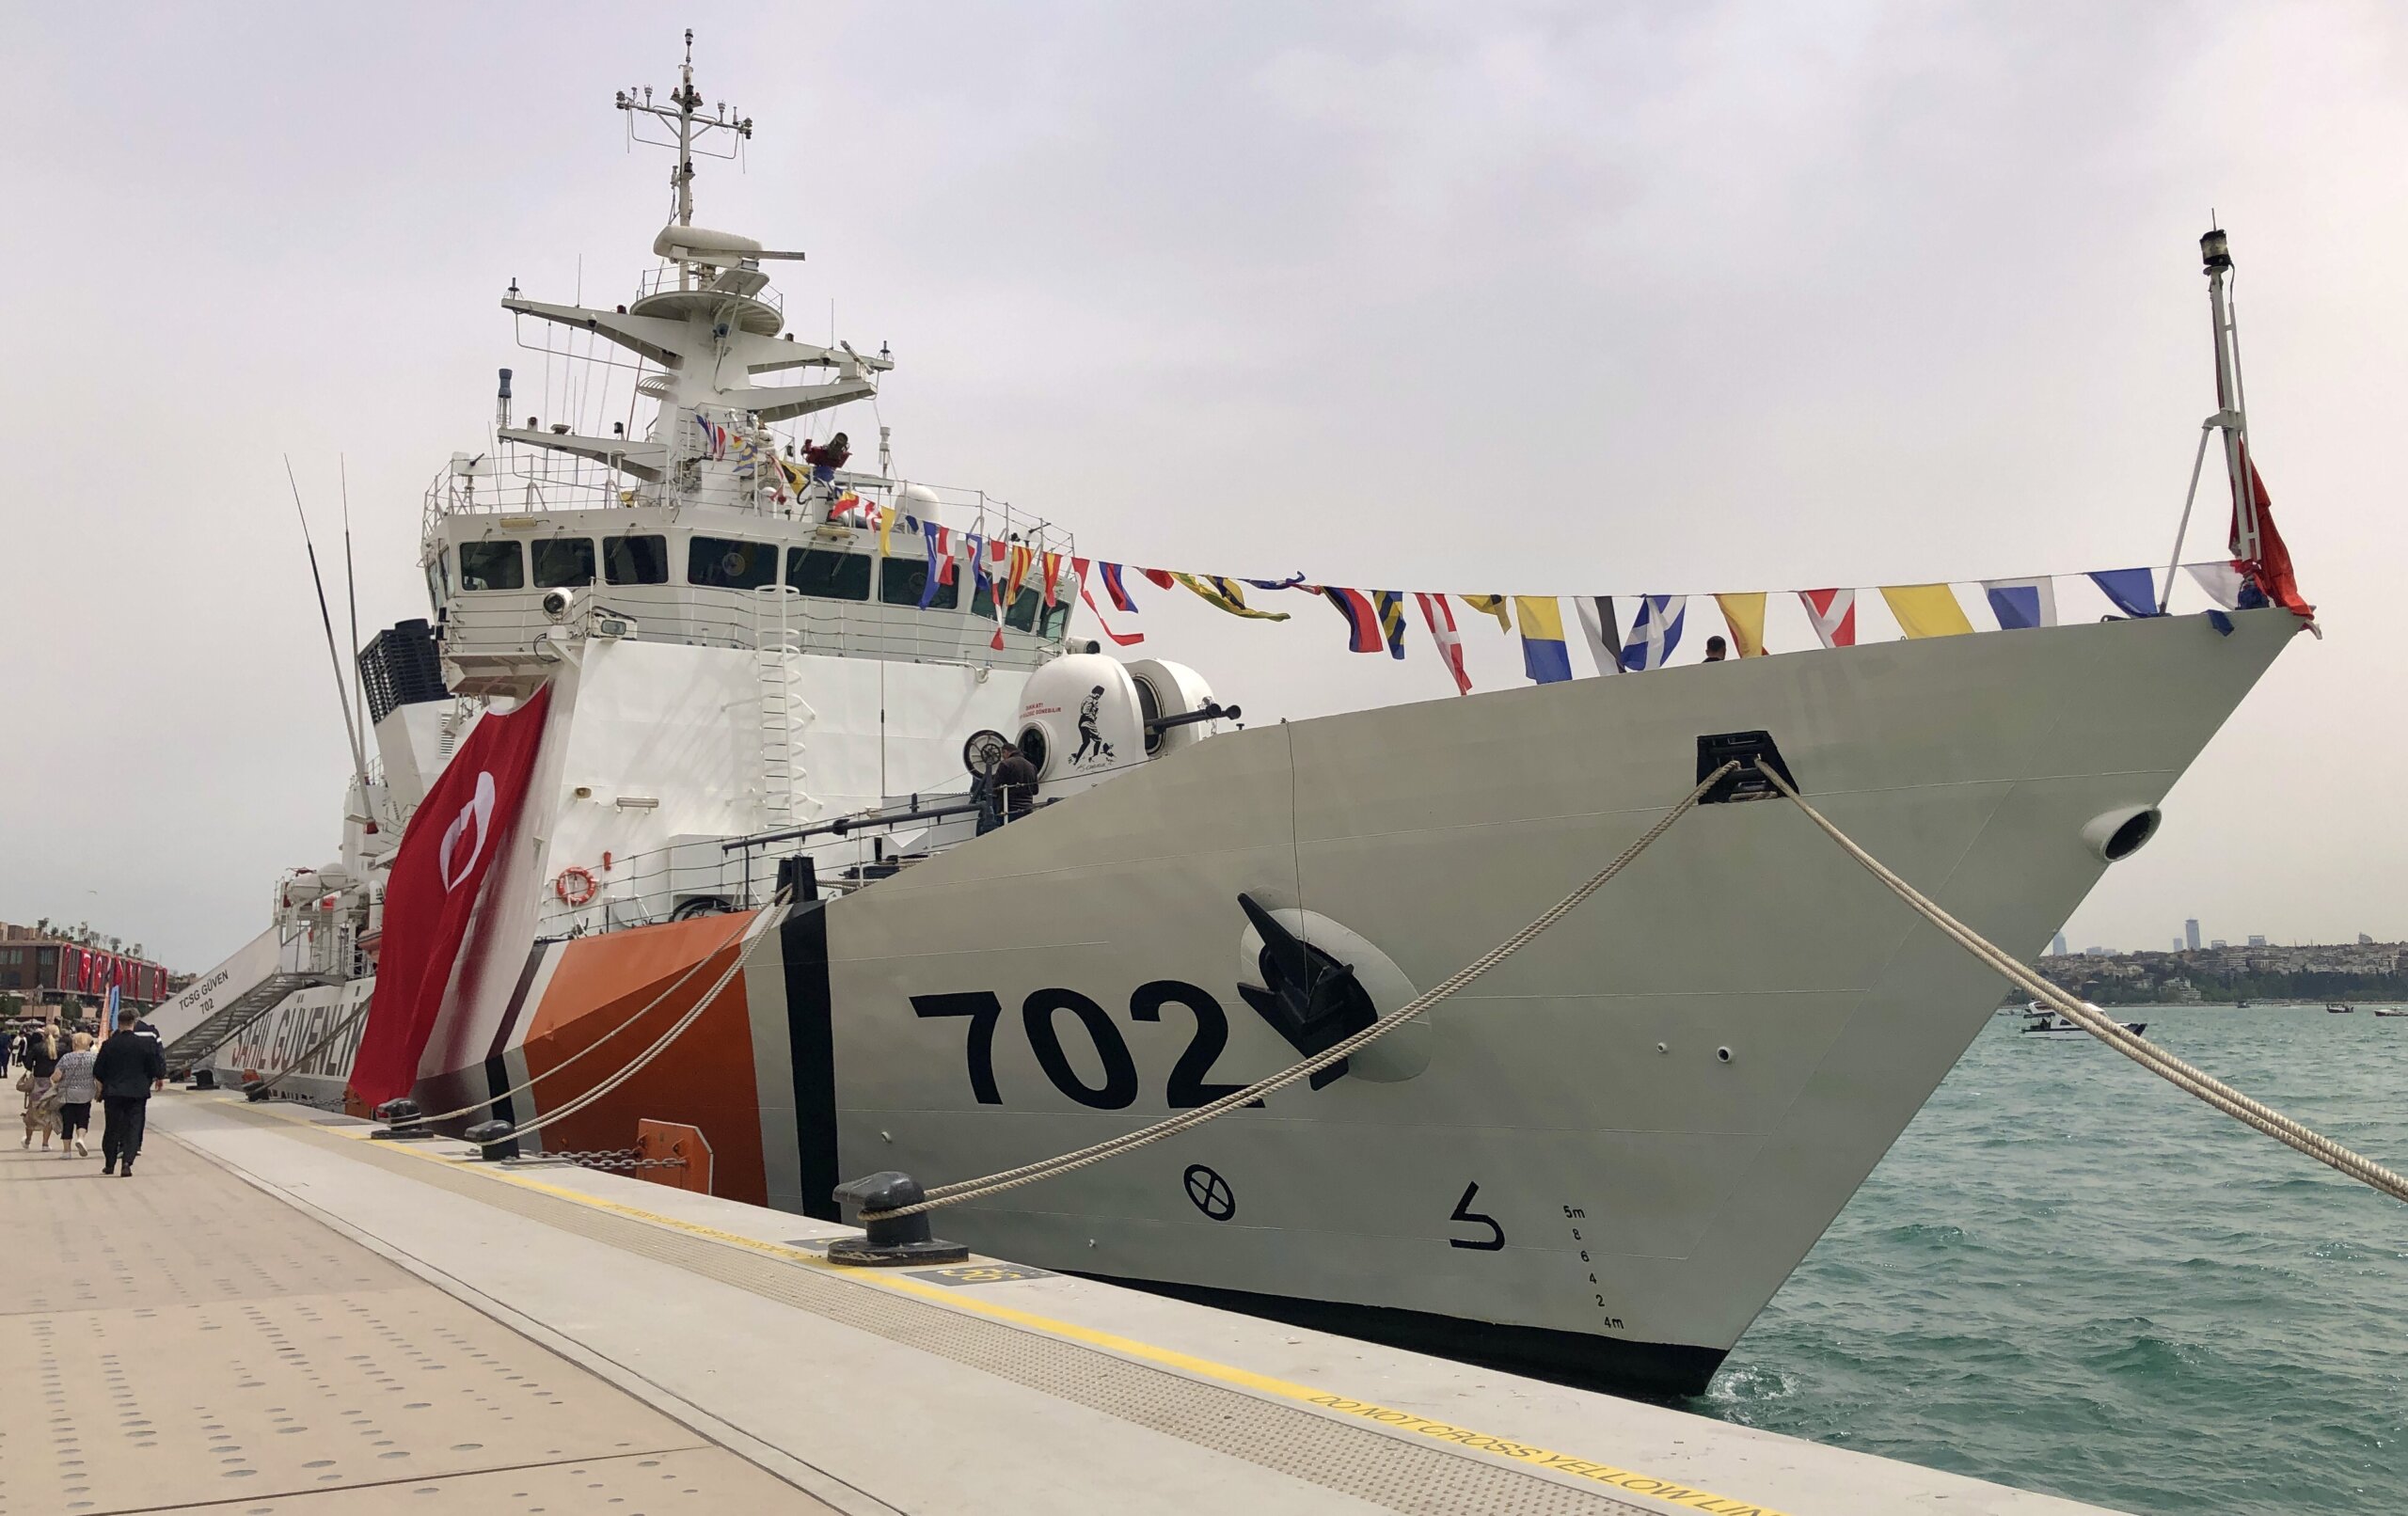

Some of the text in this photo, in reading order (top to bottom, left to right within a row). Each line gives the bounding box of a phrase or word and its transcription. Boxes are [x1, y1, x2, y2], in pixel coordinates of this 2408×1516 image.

[179, 989, 200, 1011] TCSG
[199, 998, 214, 1015] 702
[909, 980, 1266, 1110] 702
[1563, 1205, 1586, 1219] 5m
[1572, 1228, 1582, 1240] 8
[1580, 1250, 1590, 1262] 6
[1589, 1272, 1597, 1285] 4
[1595, 1294, 1605, 1307] 2
[1604, 1317, 1624, 1330] 4m
[1308, 1396, 1361, 1409] DO
[1358, 1407, 1434, 1426] NOT
[1418, 1425, 1543, 1458] CROSS
[1539, 1455, 1706, 1500] YELLOW
